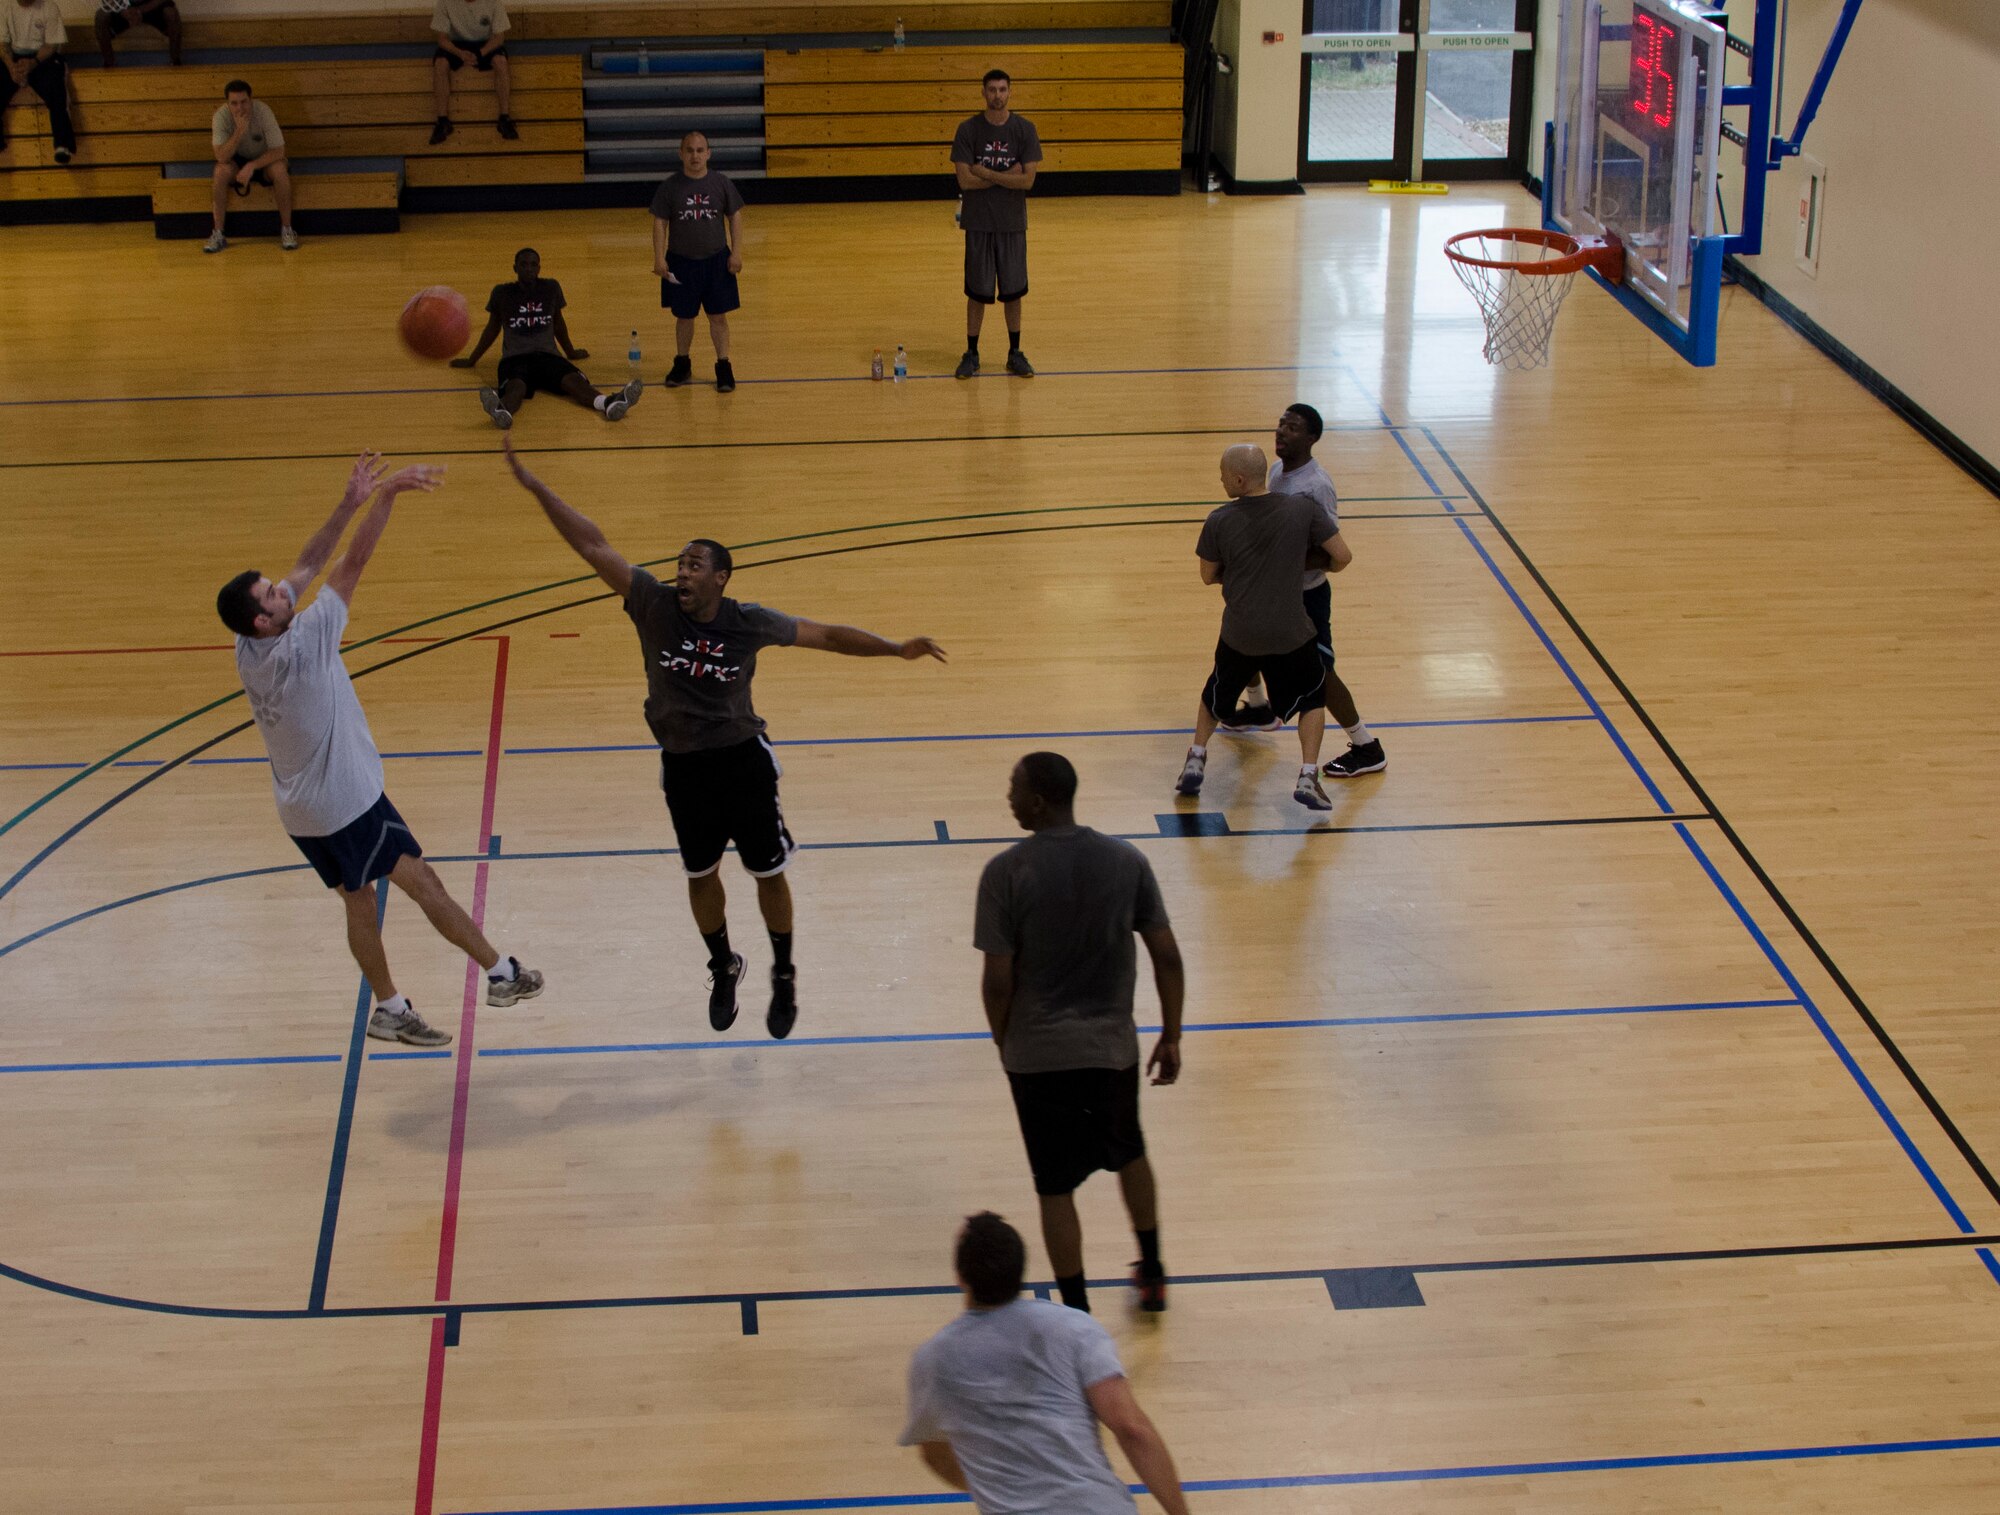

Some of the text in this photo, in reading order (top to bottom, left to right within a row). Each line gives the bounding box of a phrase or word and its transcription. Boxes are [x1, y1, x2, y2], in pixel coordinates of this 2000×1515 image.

[1324, 39, 1391, 48] PUSH TO OPEN
[1442, 36, 1509, 46] PUSH TO OPEN
[1634, 14, 1675, 128] 35
